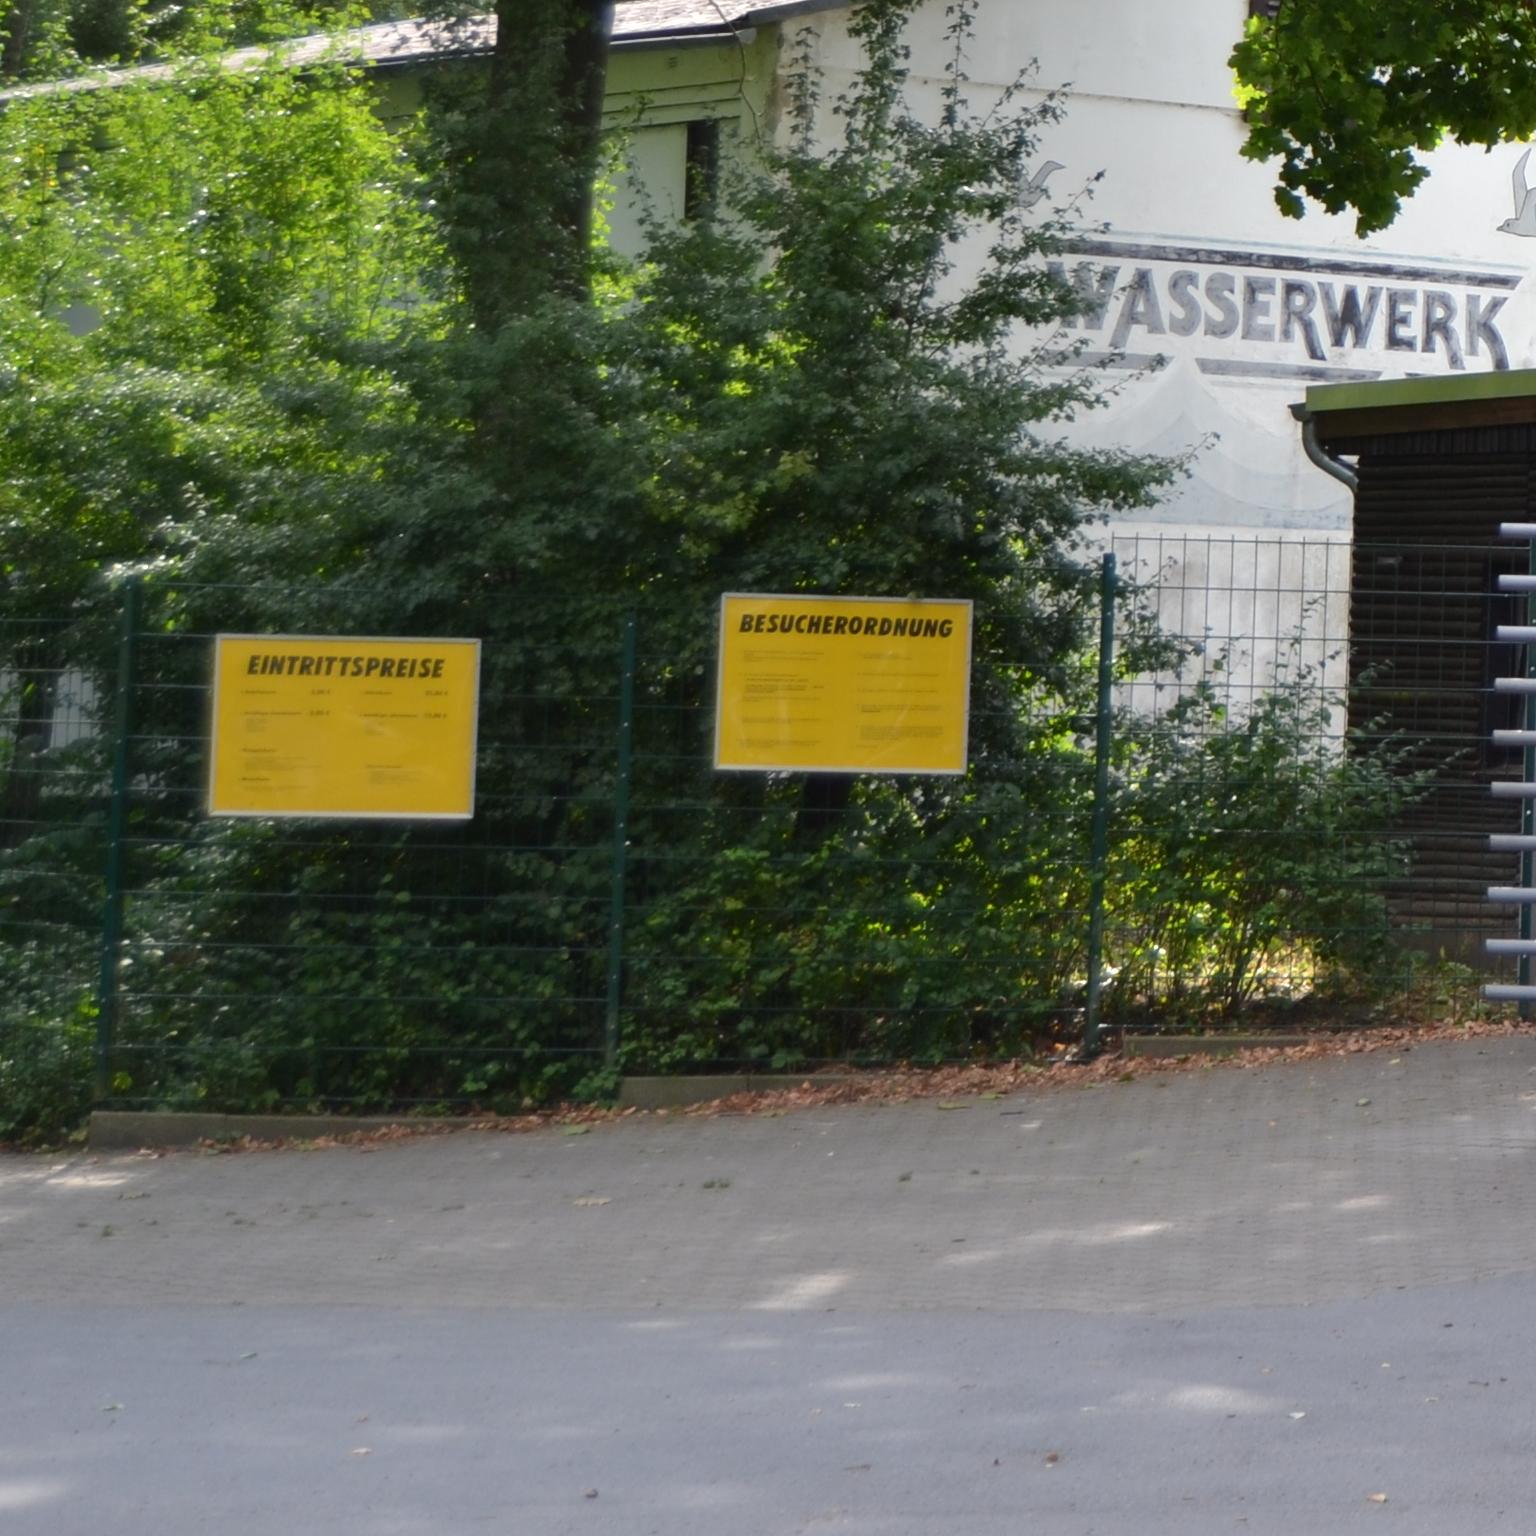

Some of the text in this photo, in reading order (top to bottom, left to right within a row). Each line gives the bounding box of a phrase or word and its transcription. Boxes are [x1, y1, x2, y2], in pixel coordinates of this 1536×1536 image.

[1045, 260, 1510, 371] WASSERWERK
[739, 614, 953, 638] BESUCHERORDNUNG
[247, 655, 445, 678] EINTRITTSPREISE
